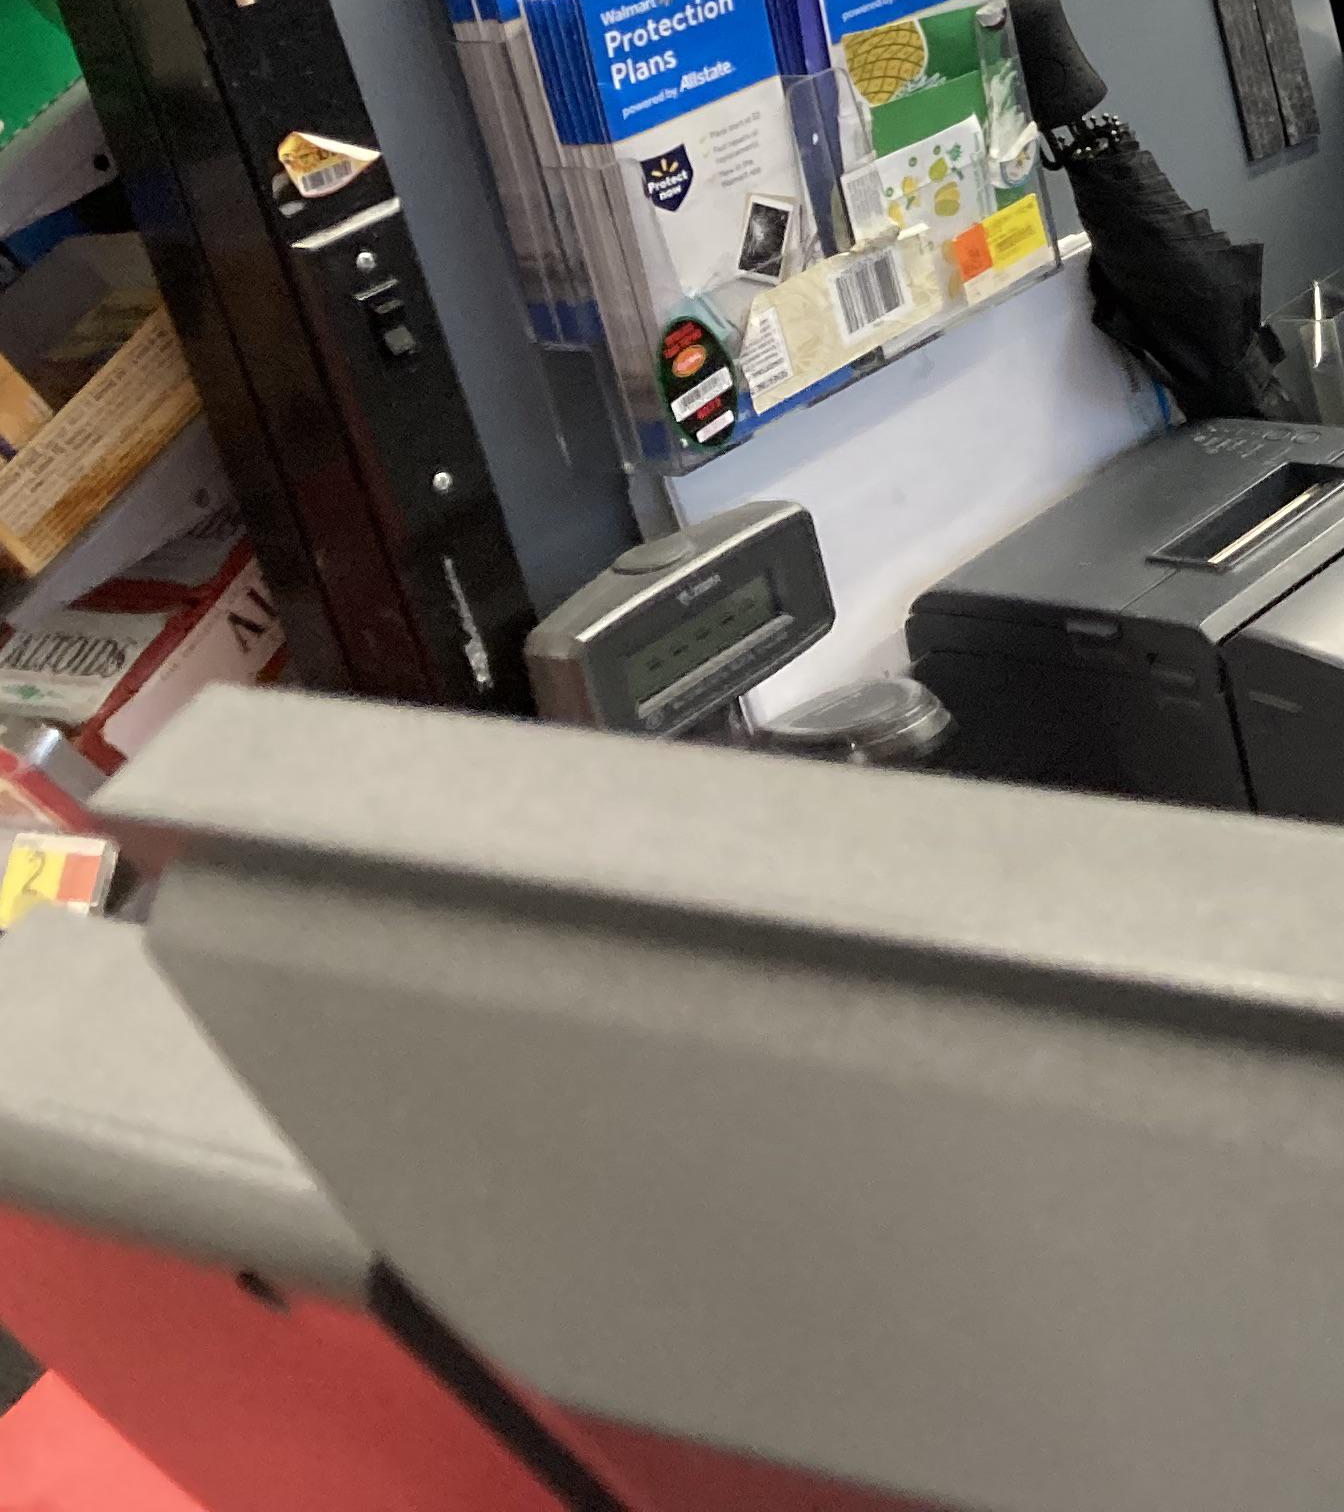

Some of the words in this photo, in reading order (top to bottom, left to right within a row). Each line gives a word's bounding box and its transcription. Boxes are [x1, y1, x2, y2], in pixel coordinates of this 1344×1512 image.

[611, 50, 676, 90] Plans
[622, 90, 665, 120] powered
[664, 87, 678, 99] by
[647, 170, 688, 194] Protect
[660, 185, 681, 201] now
[3, 631, 126, 678] ALTOIDS
